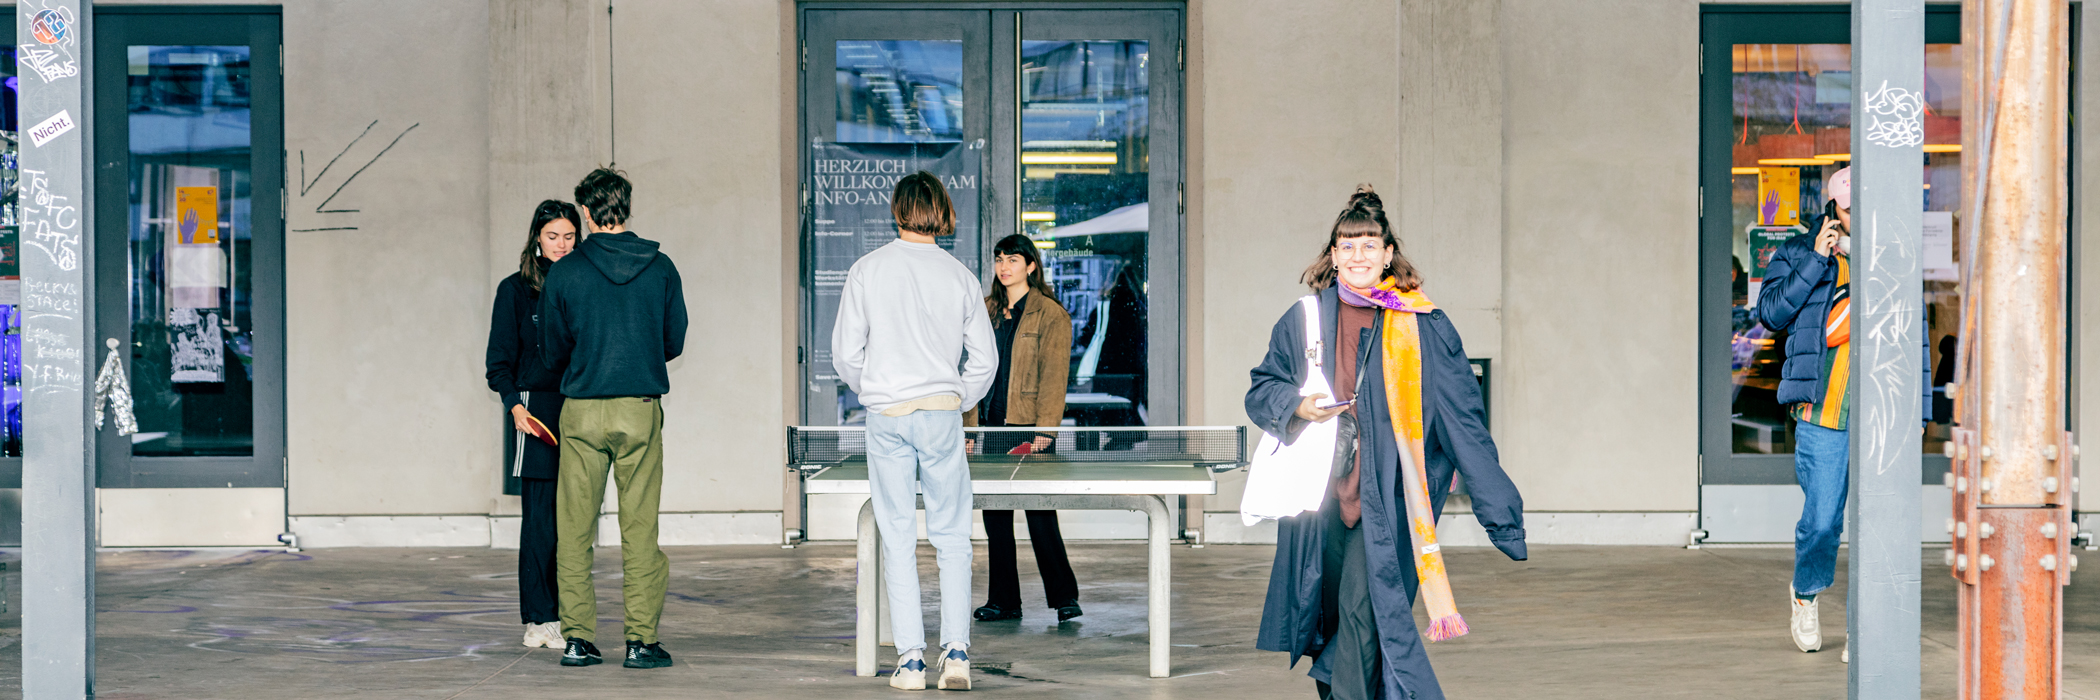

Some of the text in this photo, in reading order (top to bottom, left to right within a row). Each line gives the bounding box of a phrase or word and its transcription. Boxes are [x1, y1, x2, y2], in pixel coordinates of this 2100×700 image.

[33, 117, 71, 142] Nicht.
[814, 159, 907, 174] HERZLICH
[813, 174, 976, 190] WILLKOM AM
[814, 190, 894, 206] INFO-AN
[1085, 234, 1094, 246] A
